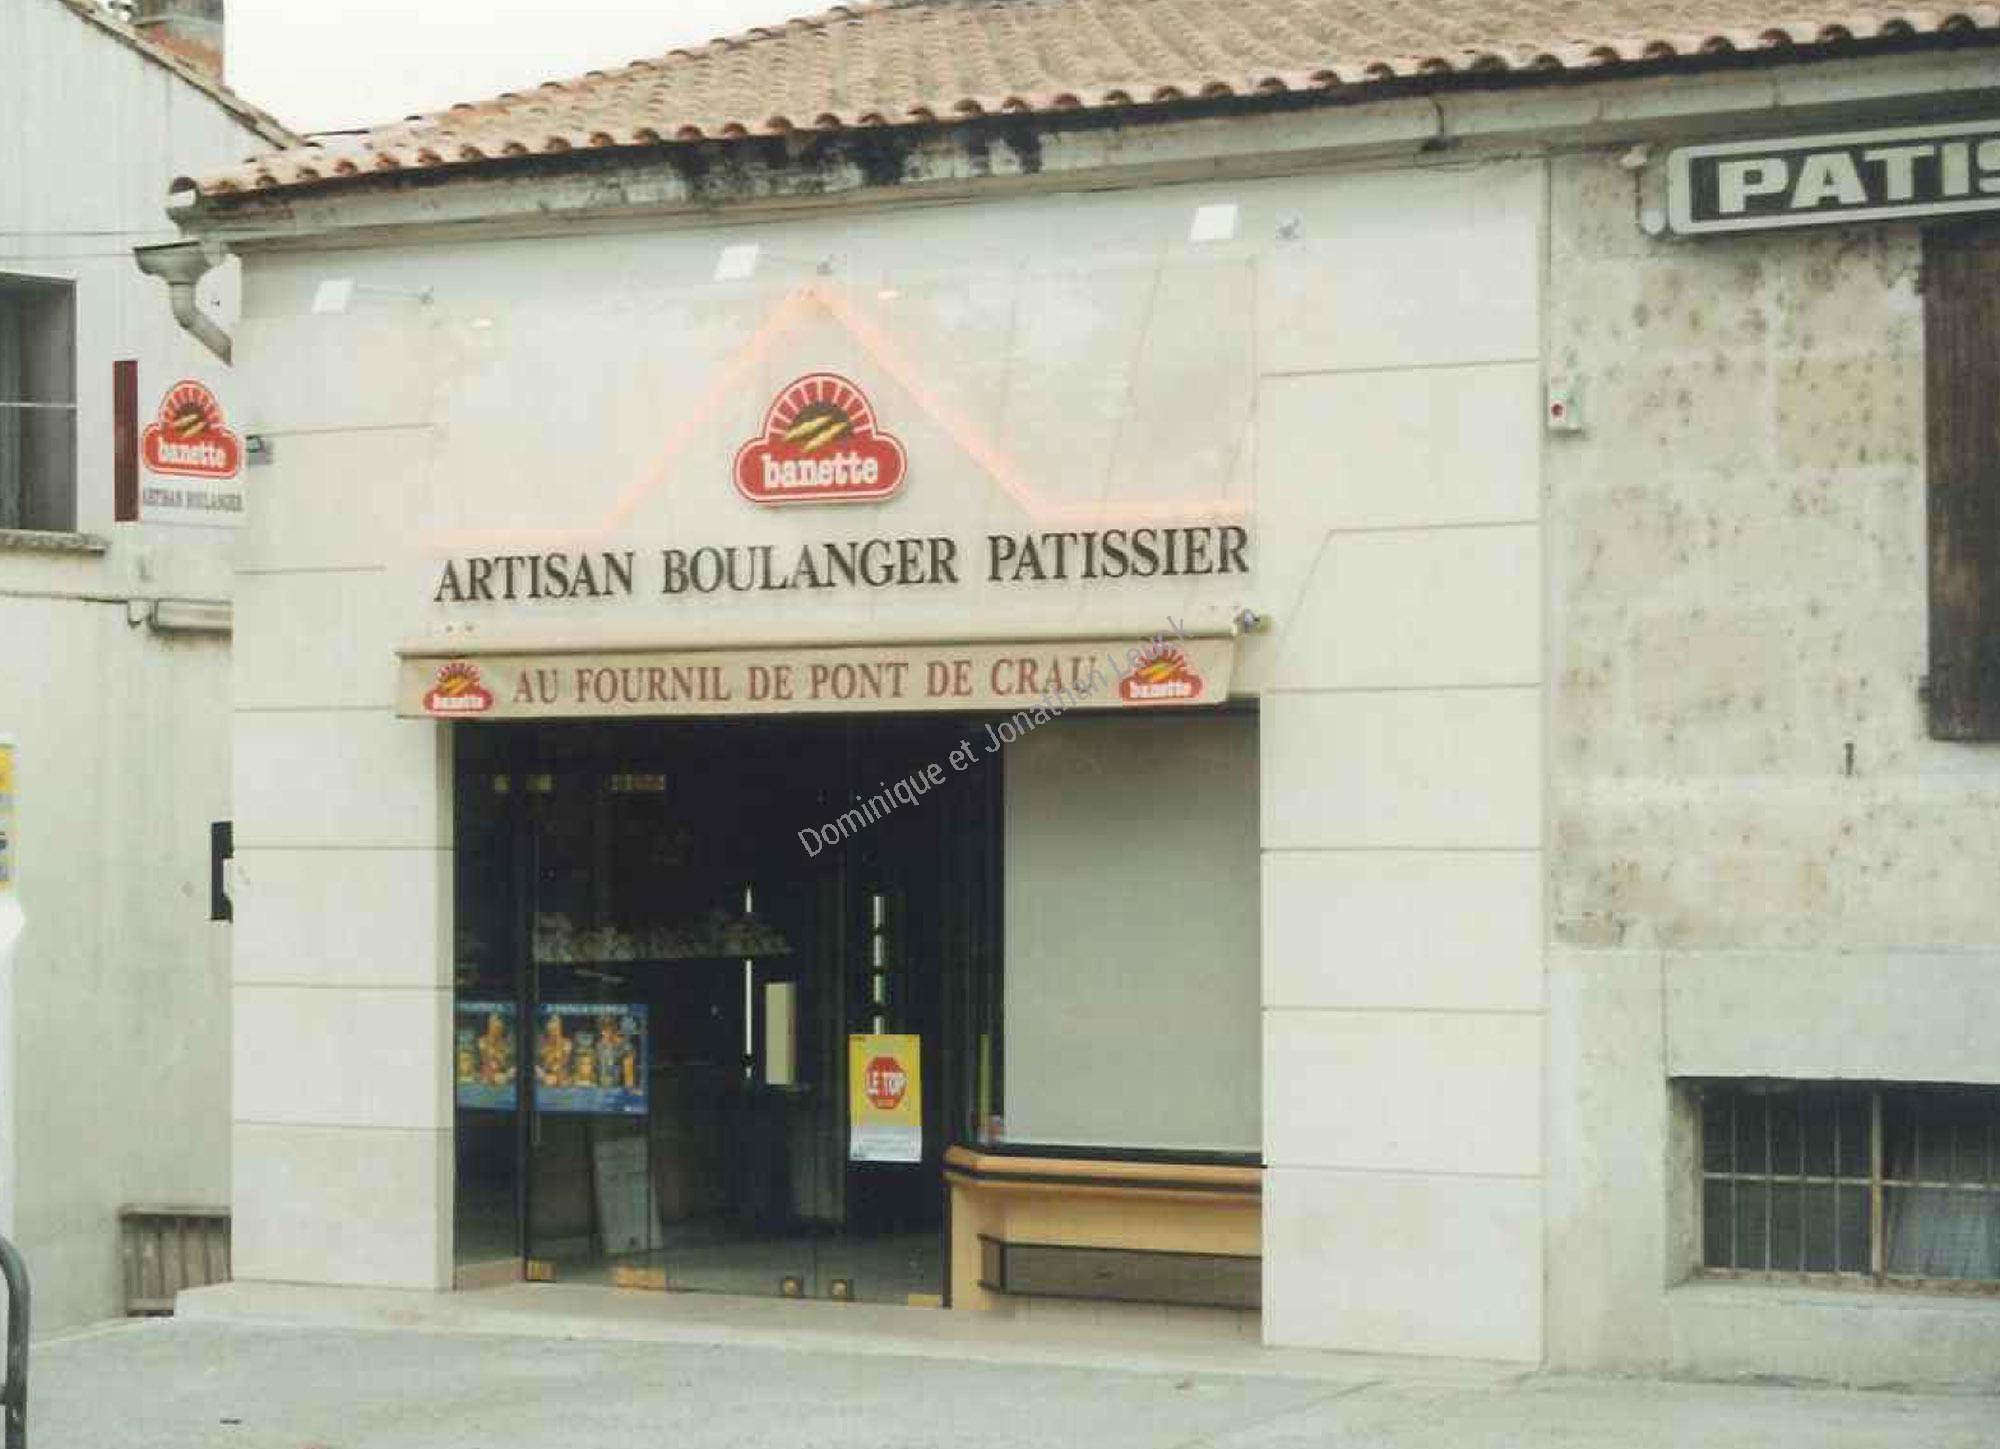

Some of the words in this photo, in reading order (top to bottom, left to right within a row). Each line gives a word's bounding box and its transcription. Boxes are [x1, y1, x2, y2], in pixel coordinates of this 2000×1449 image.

[158, 436, 227, 468] banette
[761, 452, 878, 489] banette
[434, 551, 634, 602] ARTISAN
[662, 537, 959, 595] BOULANGER
[987, 525, 1250, 583] PATISSIER
[513, 667, 559, 704] AU
[576, 666, 732, 703] FOURNIL
[746, 665, 794, 701] DE
[810, 662, 909, 699] PONT
[926, 660, 973, 698] DE
[991, 656, 1097, 695] CRAU
[867, 1071, 879, 1096] LE
[883, 1071, 907, 1096] TOP
